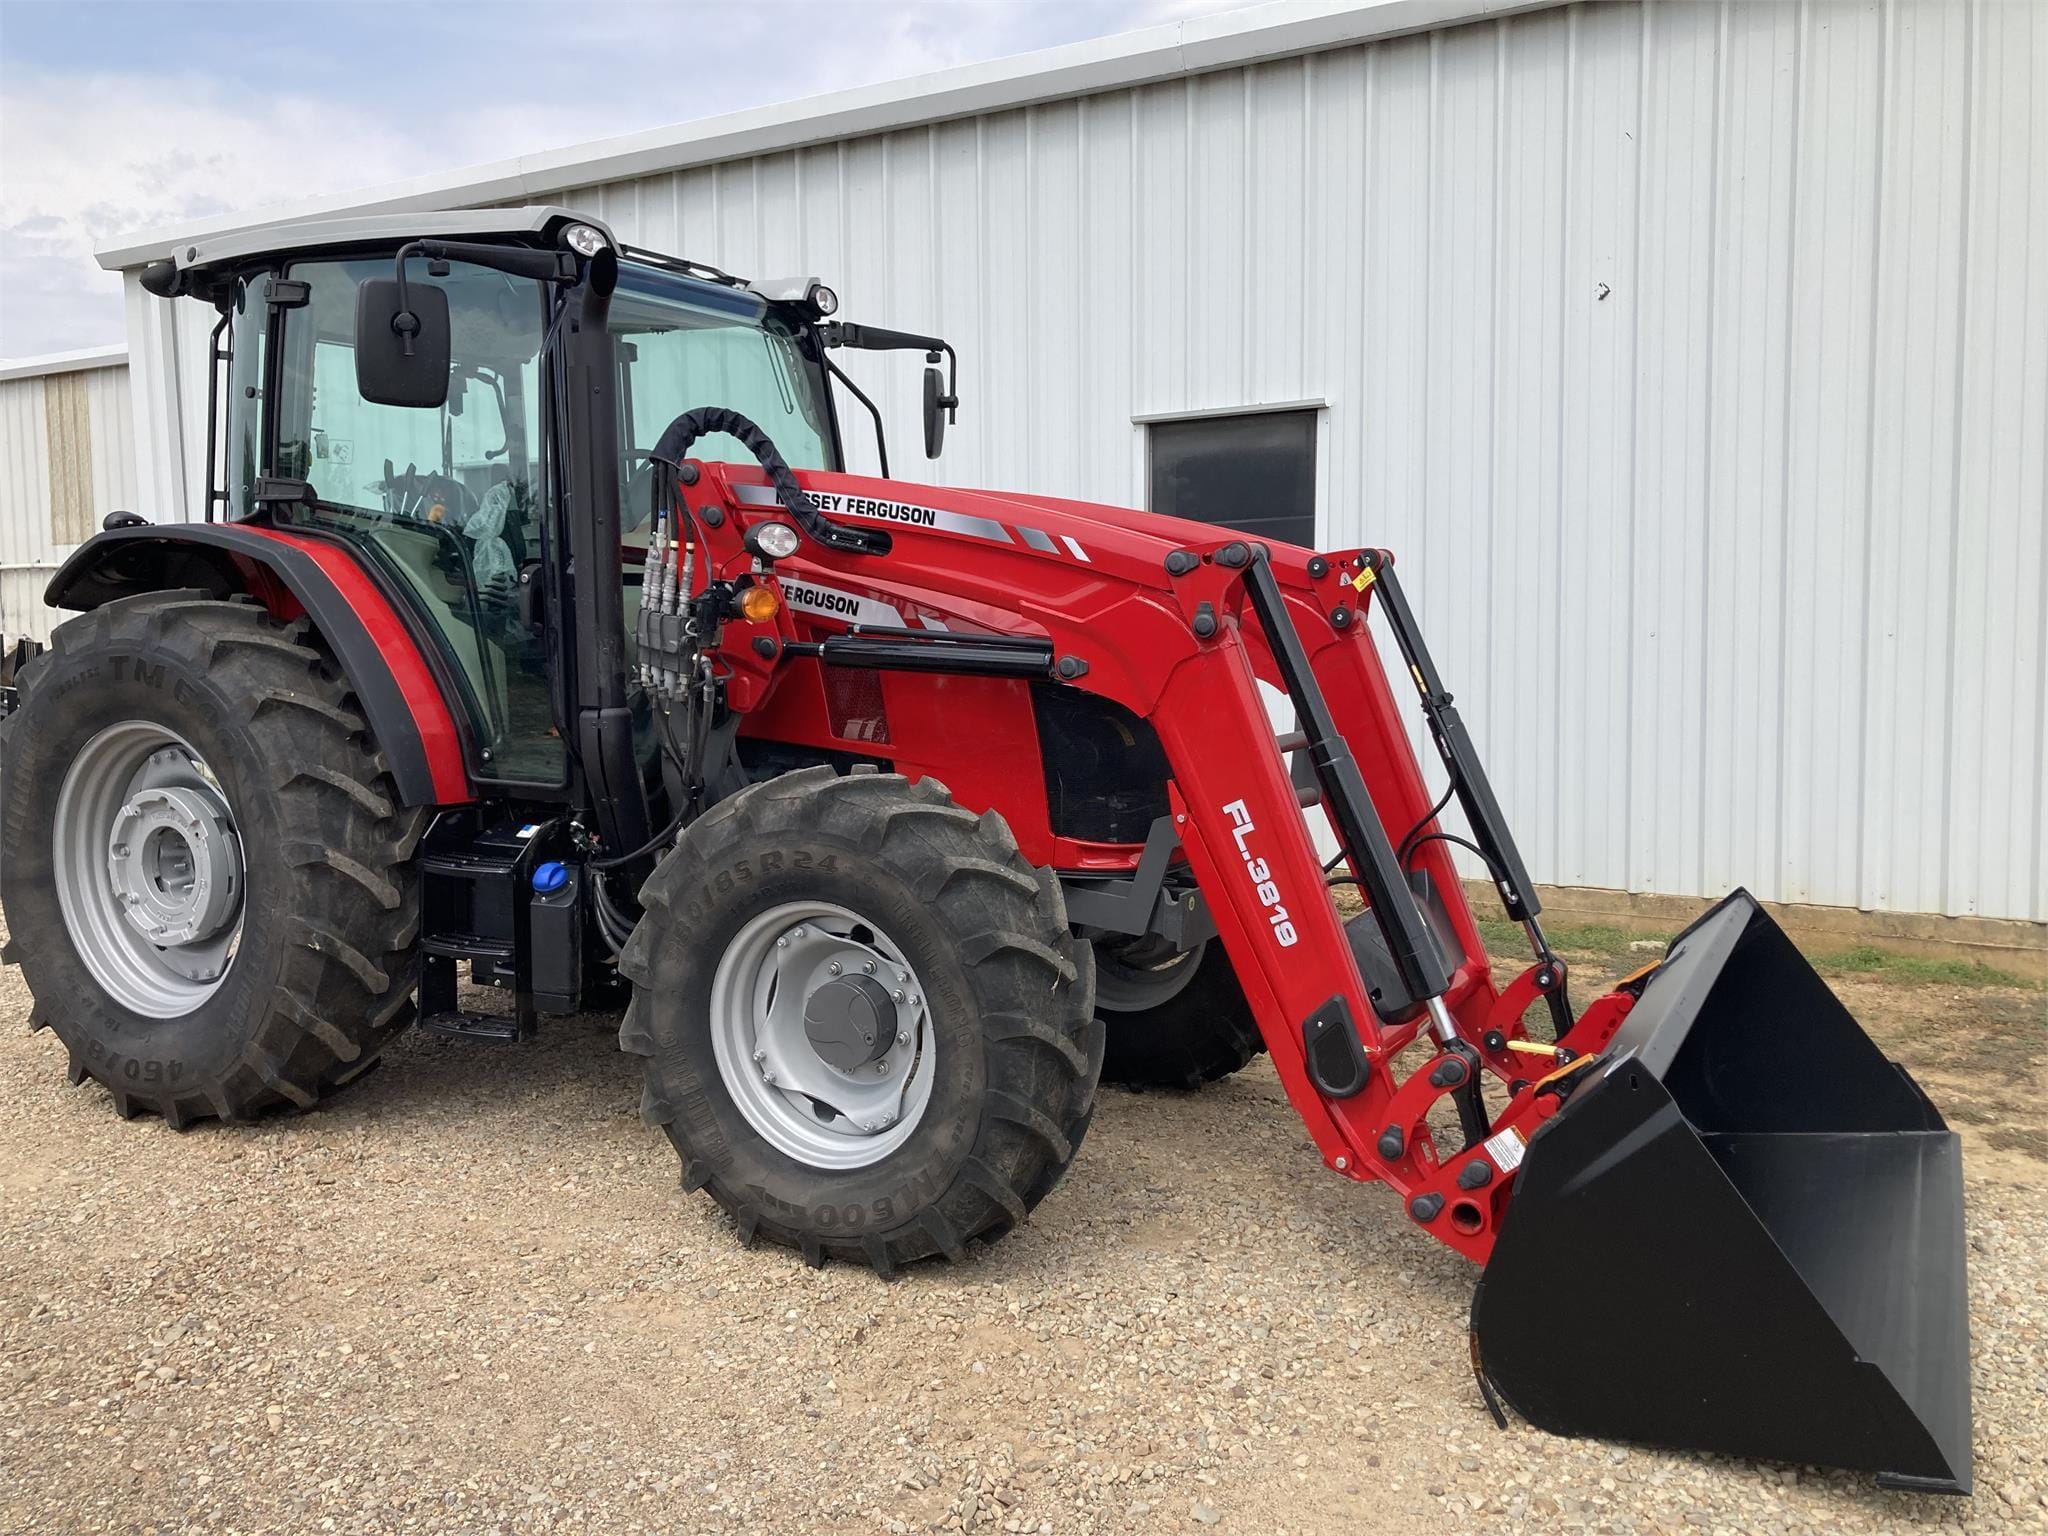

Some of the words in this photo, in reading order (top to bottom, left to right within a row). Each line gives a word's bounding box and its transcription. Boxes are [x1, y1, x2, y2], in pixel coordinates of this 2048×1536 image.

[847, 498, 936, 526] FERGUSON
[780, 584, 860, 617] ERGUSON
[1221, 798, 1299, 948] FL.3819
